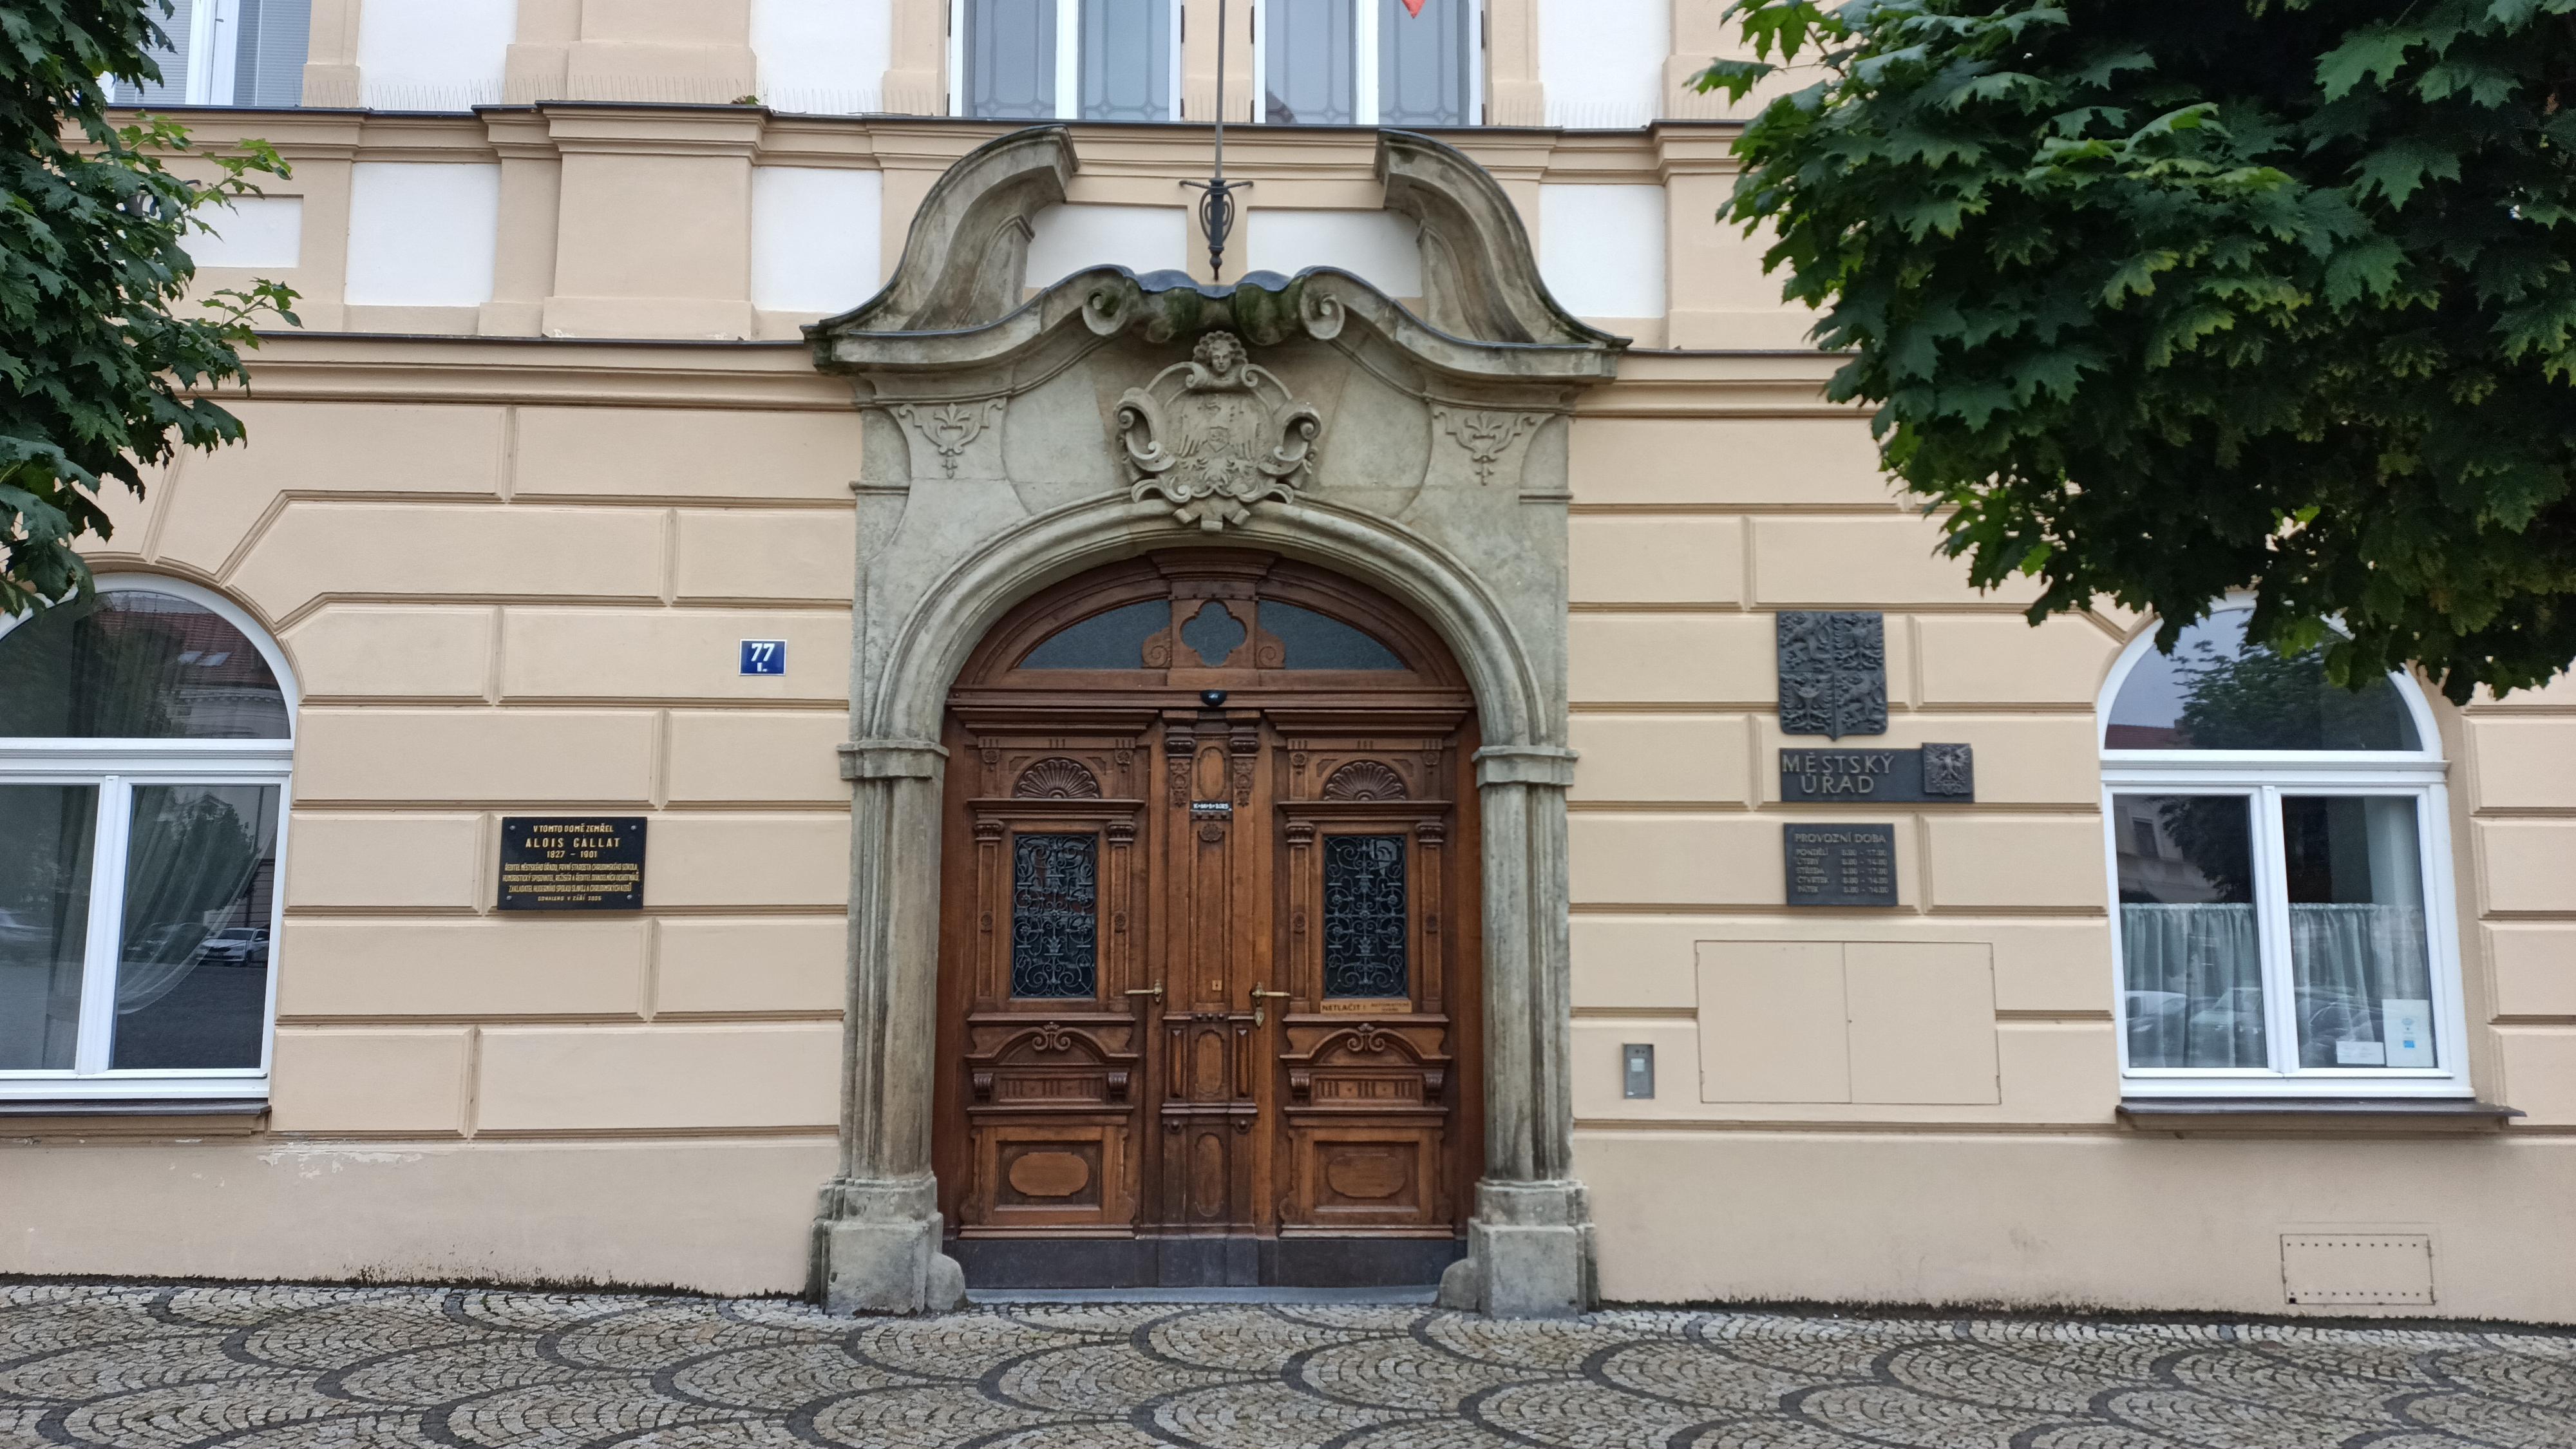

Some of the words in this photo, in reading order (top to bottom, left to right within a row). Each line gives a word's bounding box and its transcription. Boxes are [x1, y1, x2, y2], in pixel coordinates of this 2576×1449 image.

[751, 643, 775, 662] 77
[1782, 752, 1894, 773] MĚSTSKÝ
[1801, 772, 1874, 793] ÚŘAD
[564, 823, 585, 833] DOMĚ
[586, 823, 614, 833] ZEMŘEL
[526, 838, 564, 848] ALOIS
[573, 838, 620, 848] GALLAT
[1795, 831, 1852, 843] PROVOZNÍ
[1855, 833, 1886, 843] DOBA
[547, 850, 565, 858] 1827
[580, 850, 598, 858] 1901
